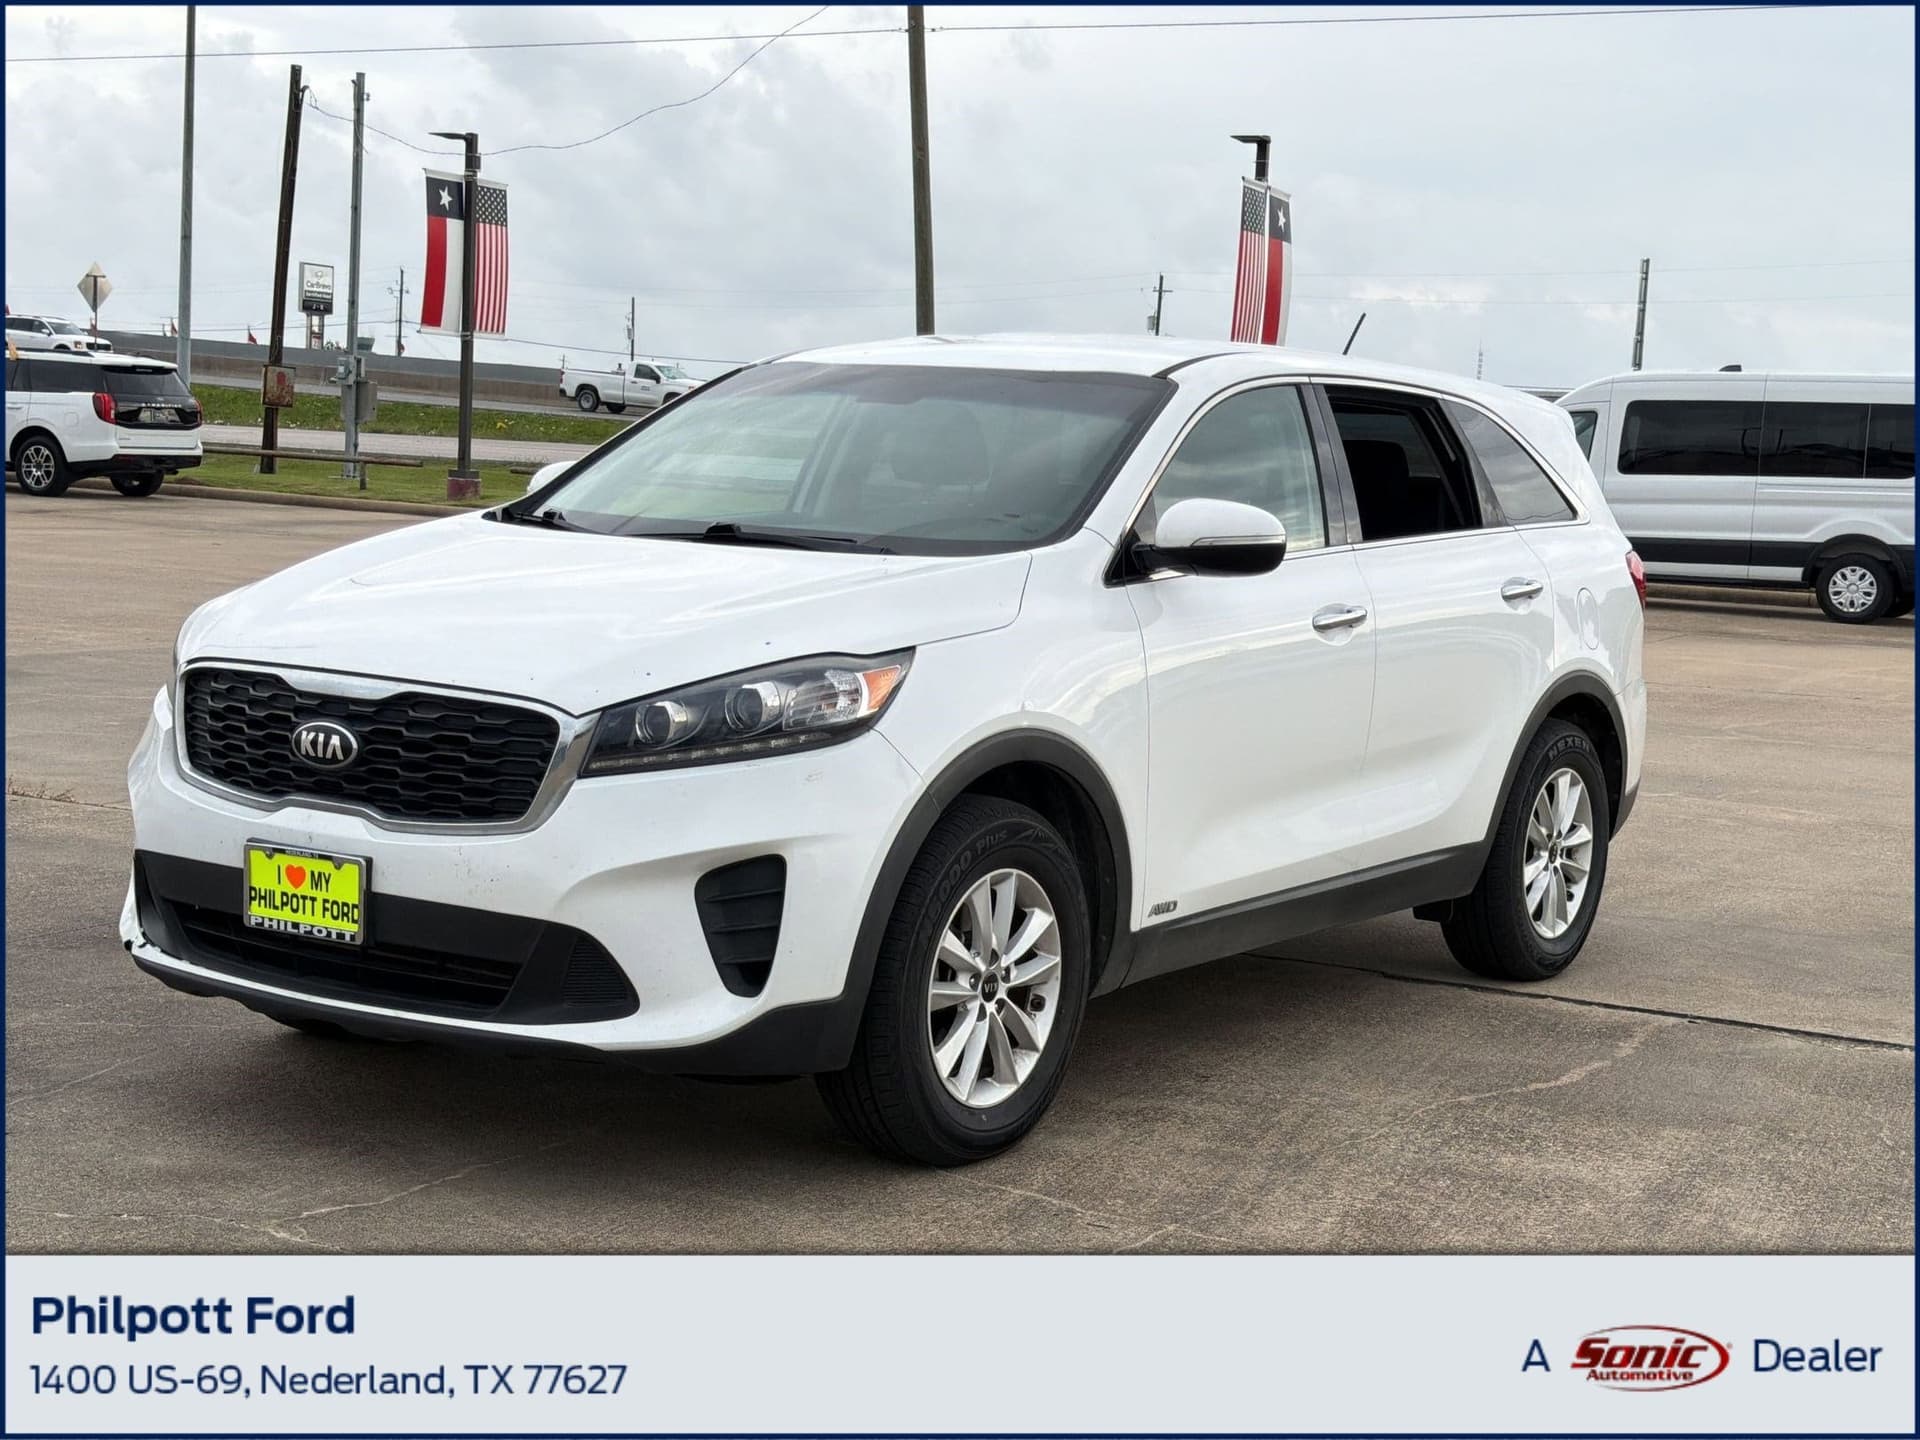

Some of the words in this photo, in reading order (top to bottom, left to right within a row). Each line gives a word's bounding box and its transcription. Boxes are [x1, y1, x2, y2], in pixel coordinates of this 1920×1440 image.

[301, 730, 344, 761] KIA
[277, 864, 282, 885] I
[310, 869, 332, 893] MY
[249, 886, 317, 917] PHILPOTT
[322, 898, 360, 924] FORD
[1147, 900, 1178, 918] AWD
[250, 915, 356, 942] PHILPOTT
